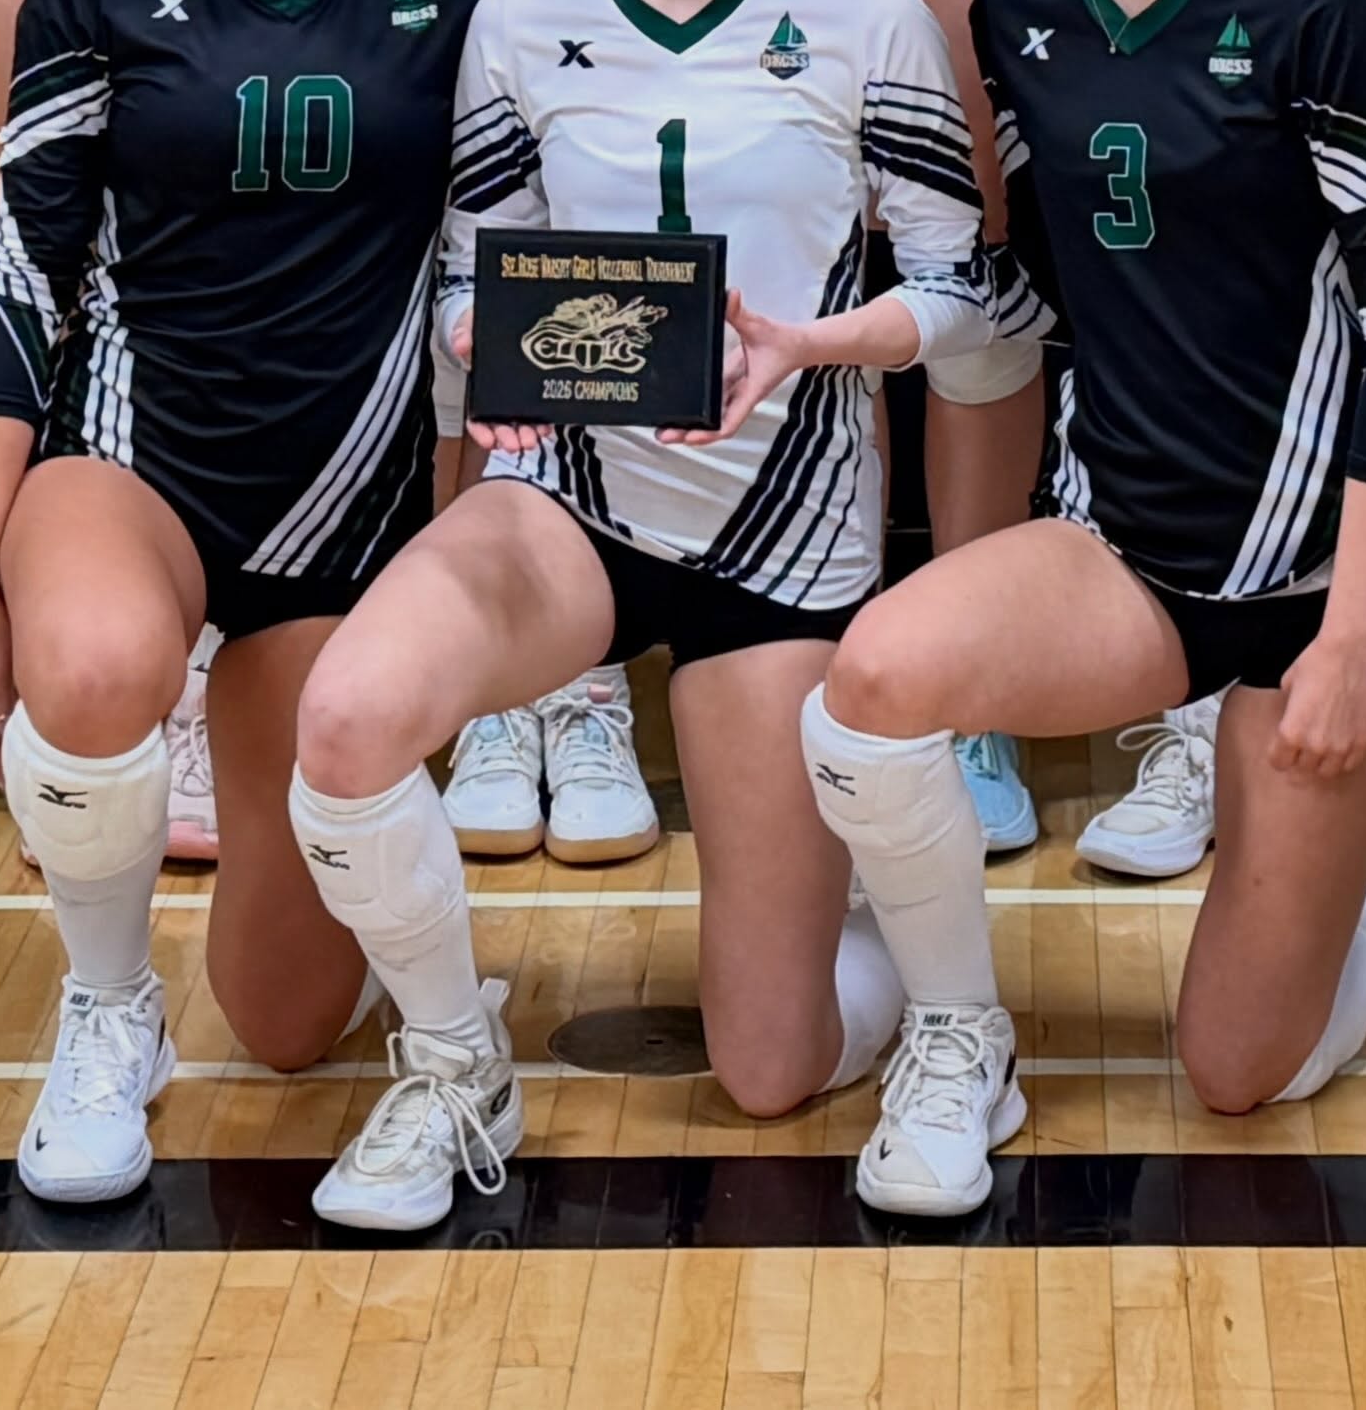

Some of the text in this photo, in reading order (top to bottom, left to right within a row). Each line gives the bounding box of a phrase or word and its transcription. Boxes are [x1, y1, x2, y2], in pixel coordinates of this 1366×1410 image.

[232, 75, 353, 192] 10
[656, 118, 692, 234] 1
[1088, 122, 1155, 250] 3
[574, 380, 639, 402] CHAMPIONS
